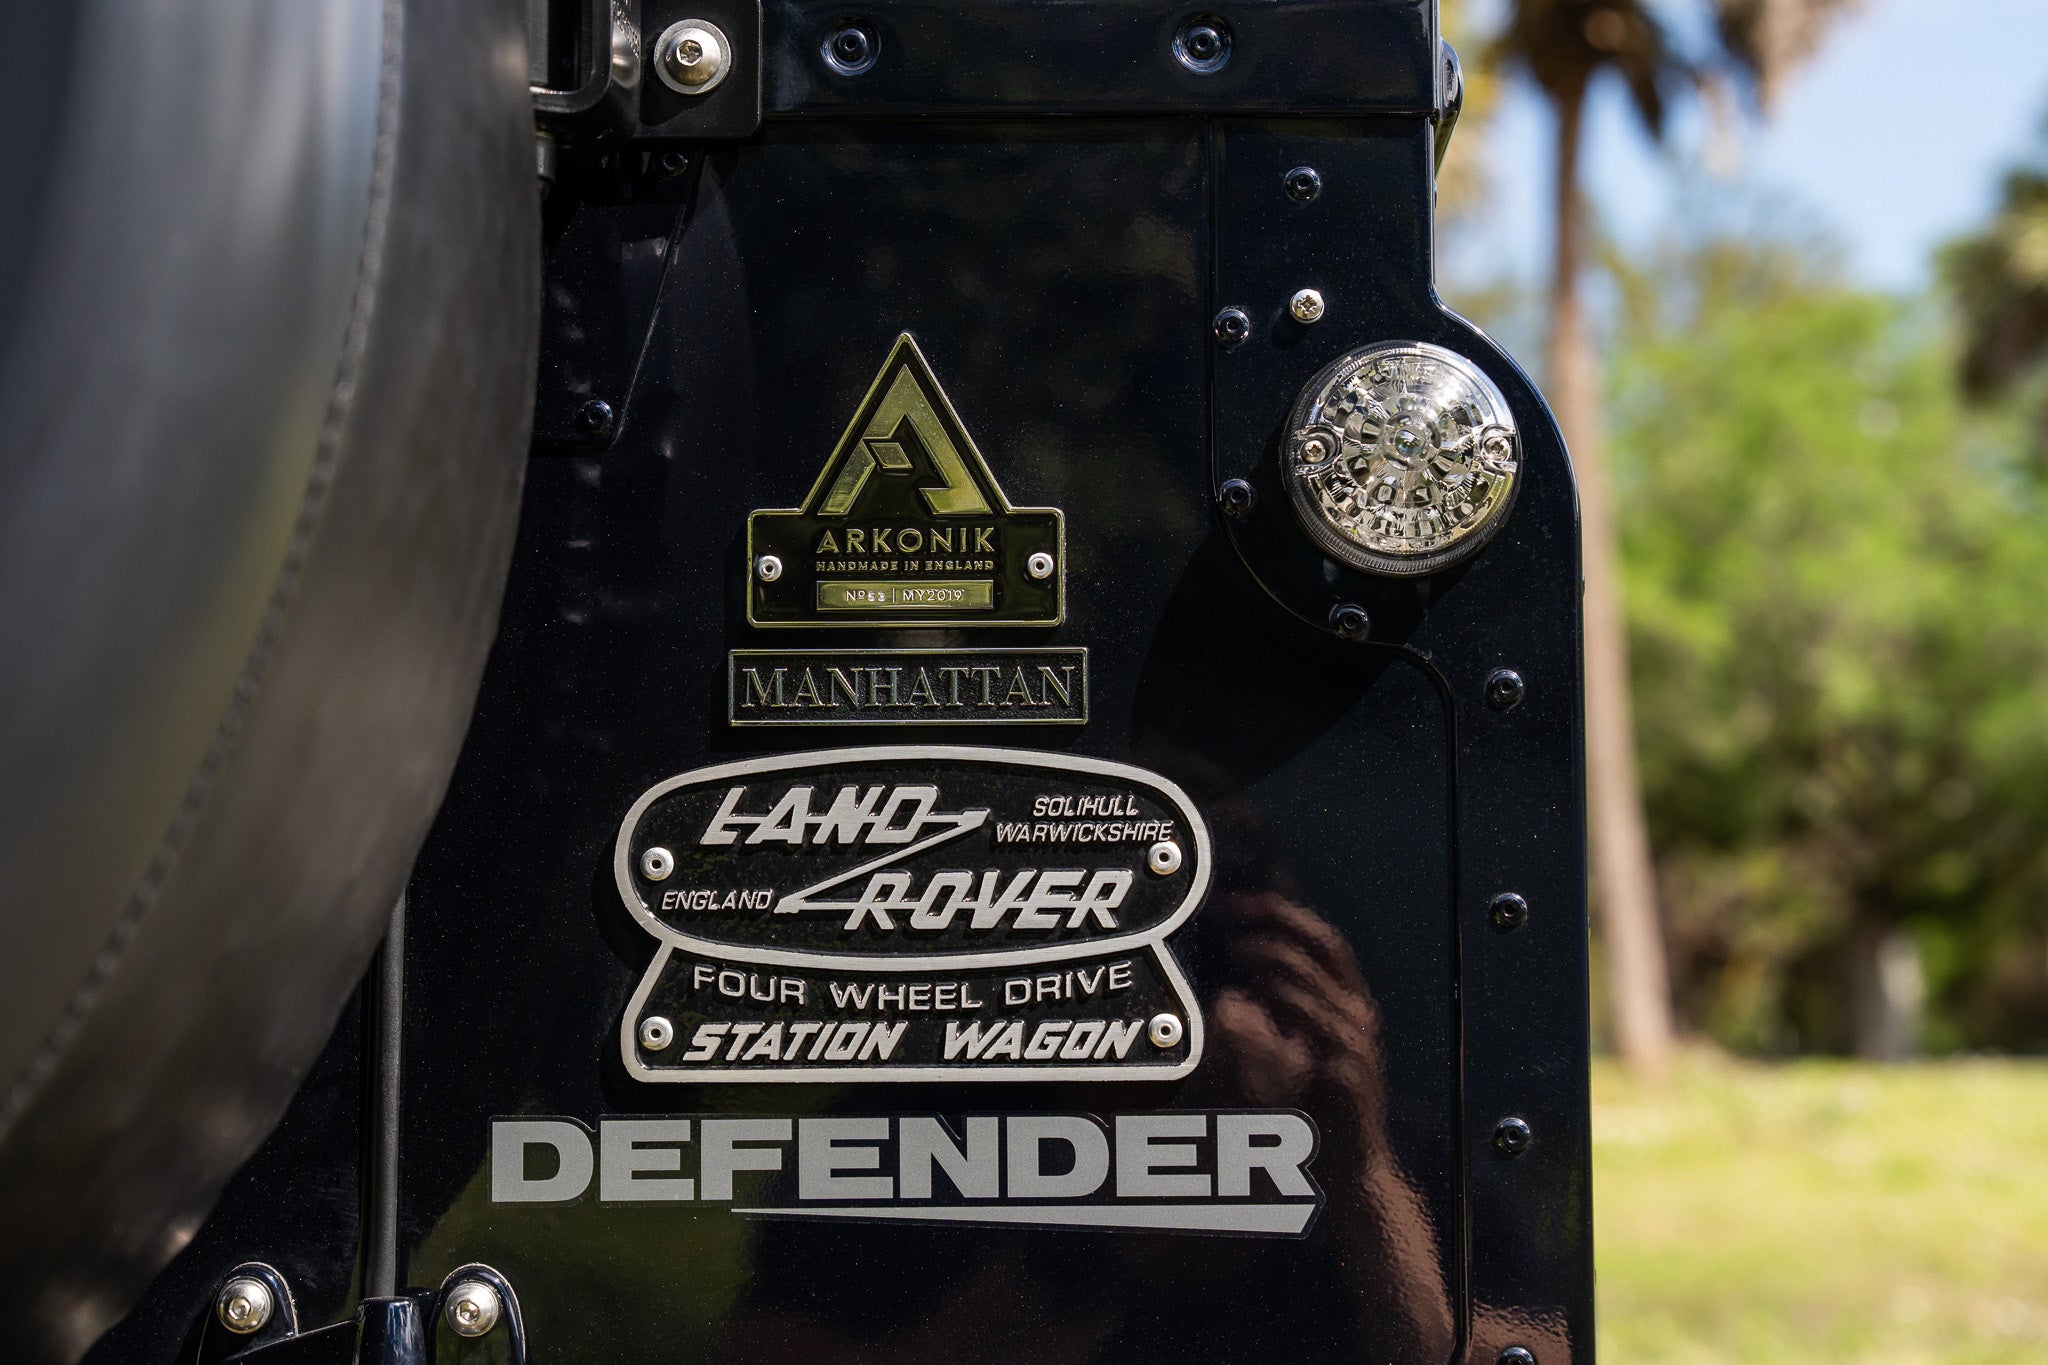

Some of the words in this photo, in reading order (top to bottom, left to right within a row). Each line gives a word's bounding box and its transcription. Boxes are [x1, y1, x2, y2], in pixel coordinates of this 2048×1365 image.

[815, 527, 995, 554] ARKONIK
[815, 561, 899, 572] HANDMADE
[904, 560, 920, 571] IN
[924, 560, 995, 571] ENGLAND
[902, 589, 963, 601] MY2019
[742, 666, 1076, 707] MANHATTAN
[700, 785, 939, 845] LAND
[1032, 794, 1140, 818] SOLIHULL
[995, 819, 1174, 844] WARWICKSHIRE
[660, 888, 773, 911] ENGLAND
[843, 868, 1134, 930] ROVER
[693, 963, 807, 1006] FOUR
[829, 981, 983, 1011] WHEEL
[1004, 959, 1133, 1006] DRIVE
[682, 1020, 909, 1063] STATION
[943, 1018, 1145, 1061] WAGON
[491, 1113, 1318, 1203] DEFENDER
